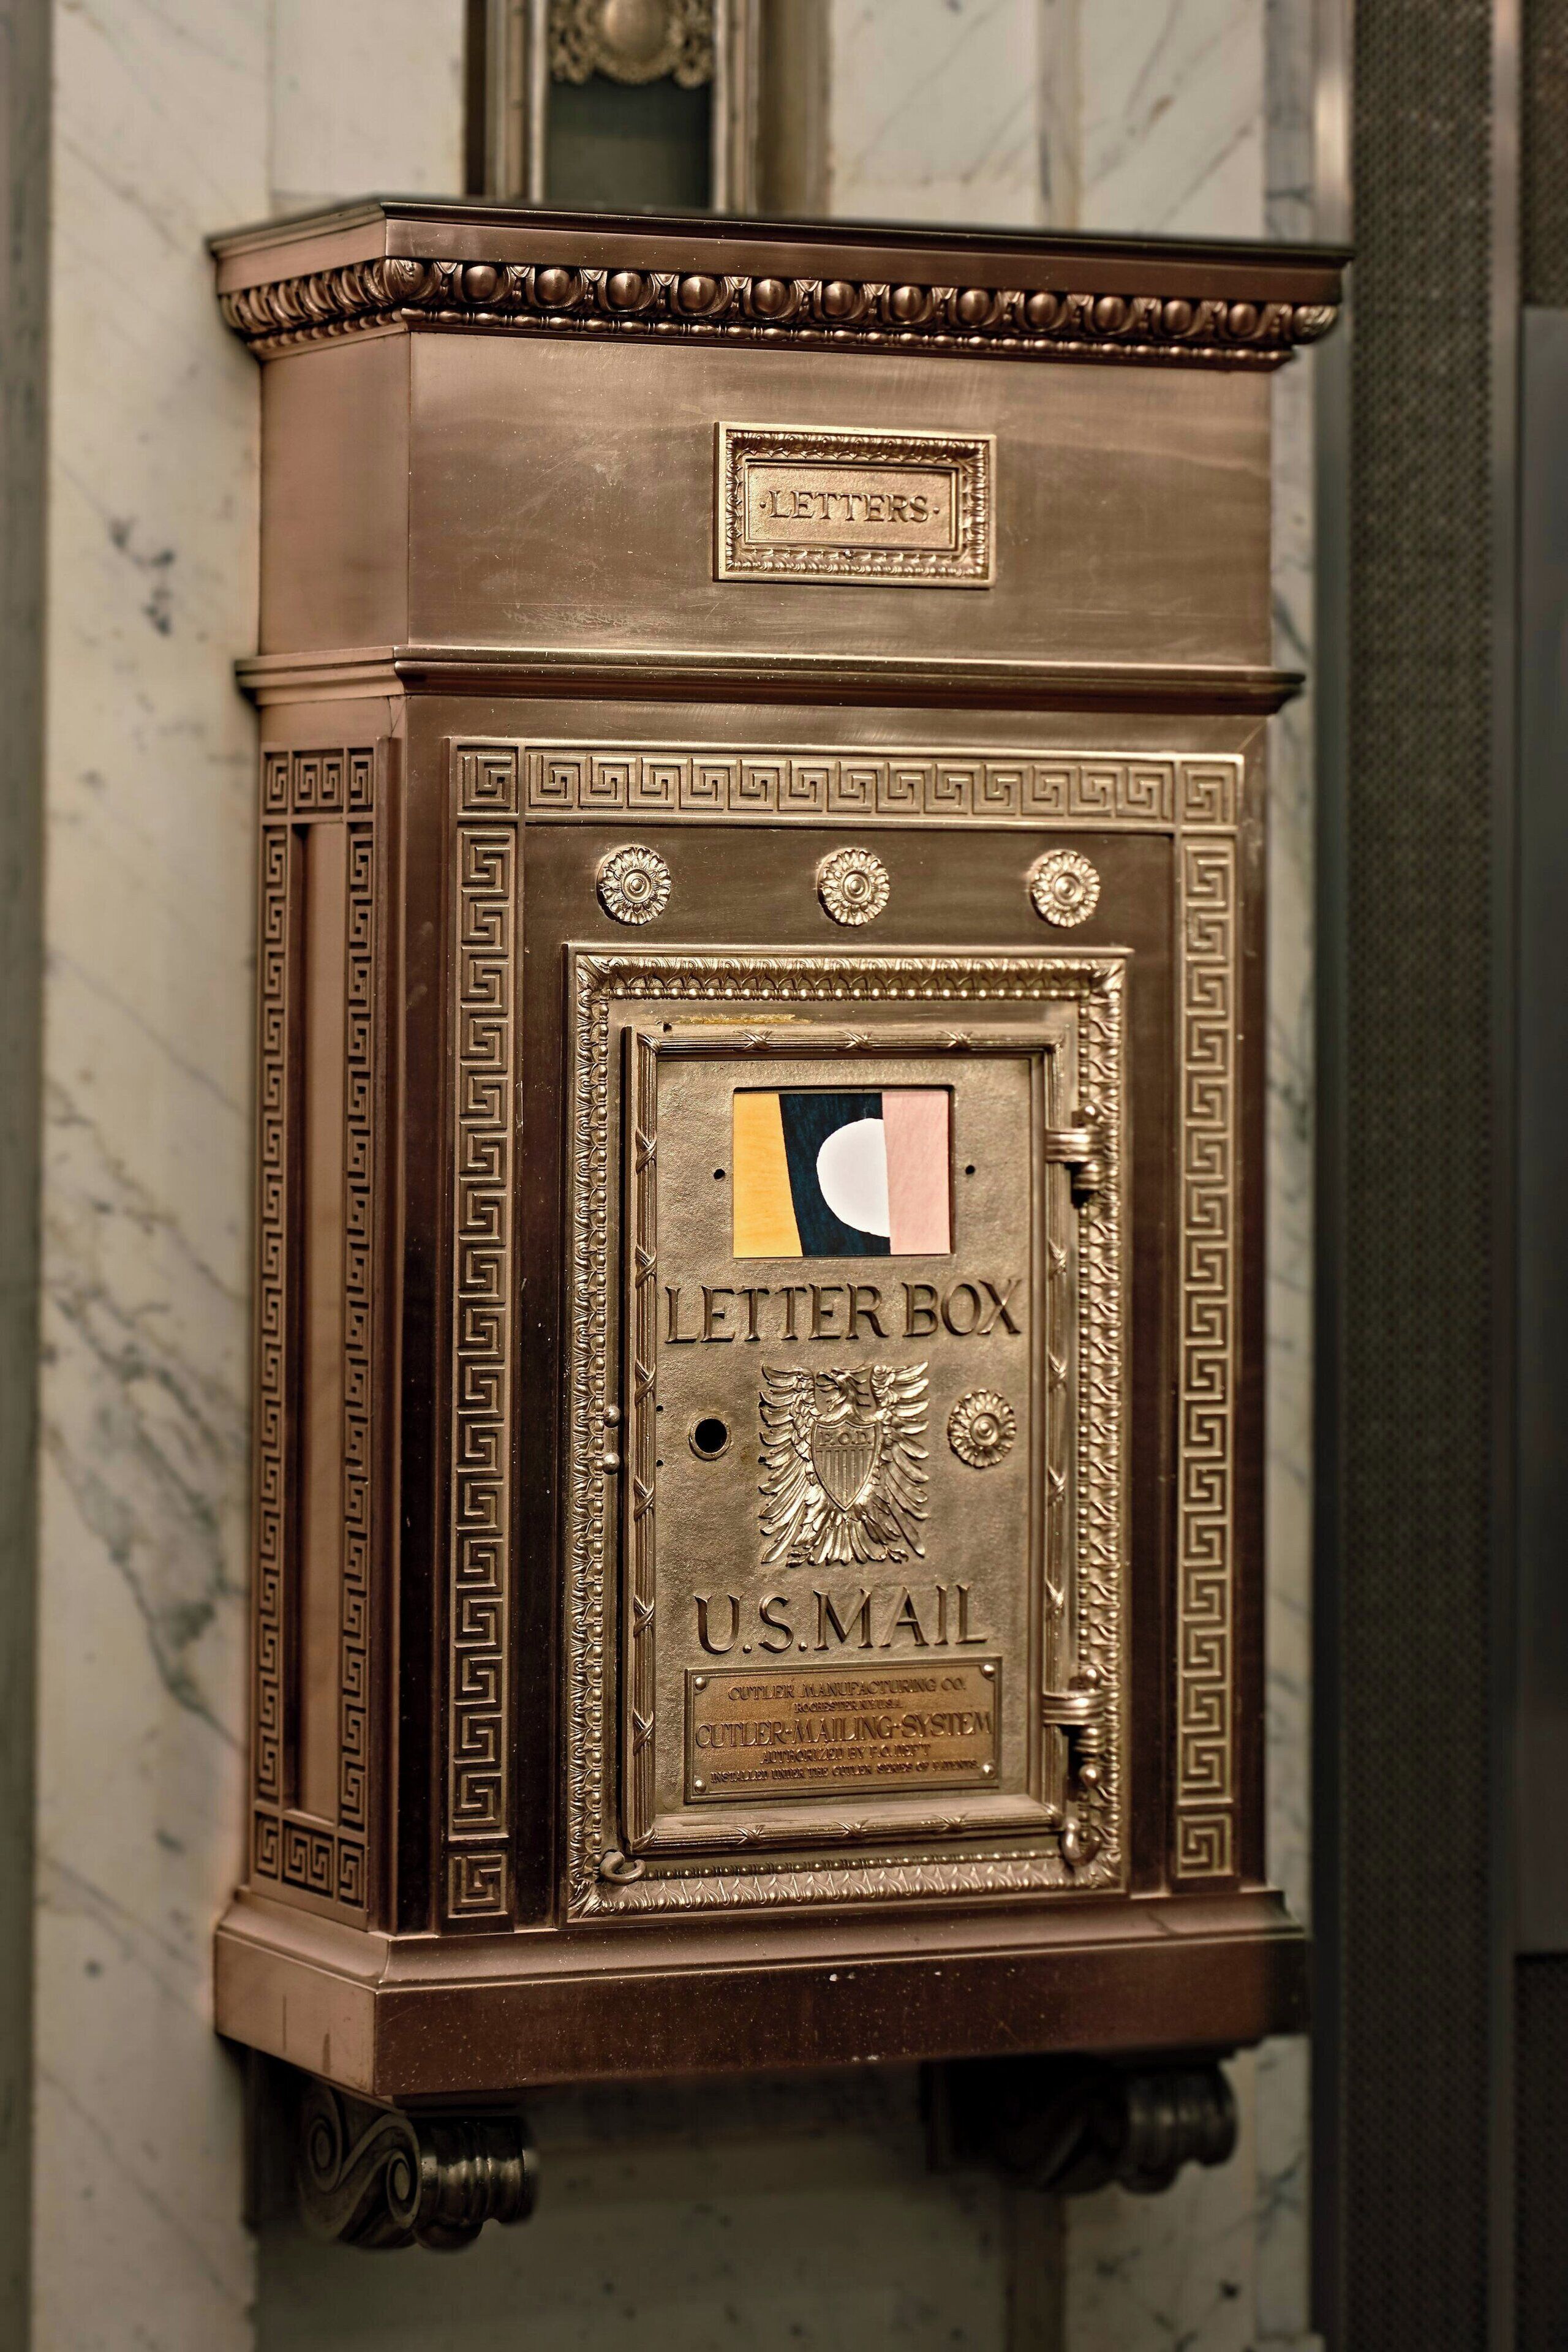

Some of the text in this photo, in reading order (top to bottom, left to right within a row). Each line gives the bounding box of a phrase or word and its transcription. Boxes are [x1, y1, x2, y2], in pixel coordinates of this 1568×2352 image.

[665, 1280, 1024, 1344] LETTER BOX
[819, 1431, 872, 1446] P.O.D.
[728, 1677, 966, 1700] CUTLER MANUFACTURING CO.
[760, 1747, 843, 1764] AUTHORIZED
[848, 1746, 865, 1759] BY
[710, 1769, 767, 1783] INSTALLED
[771, 1768, 805, 1779] UNDER
[806, 1766, 828, 1777] THE
[832, 1765, 872, 1776] CUTLER
